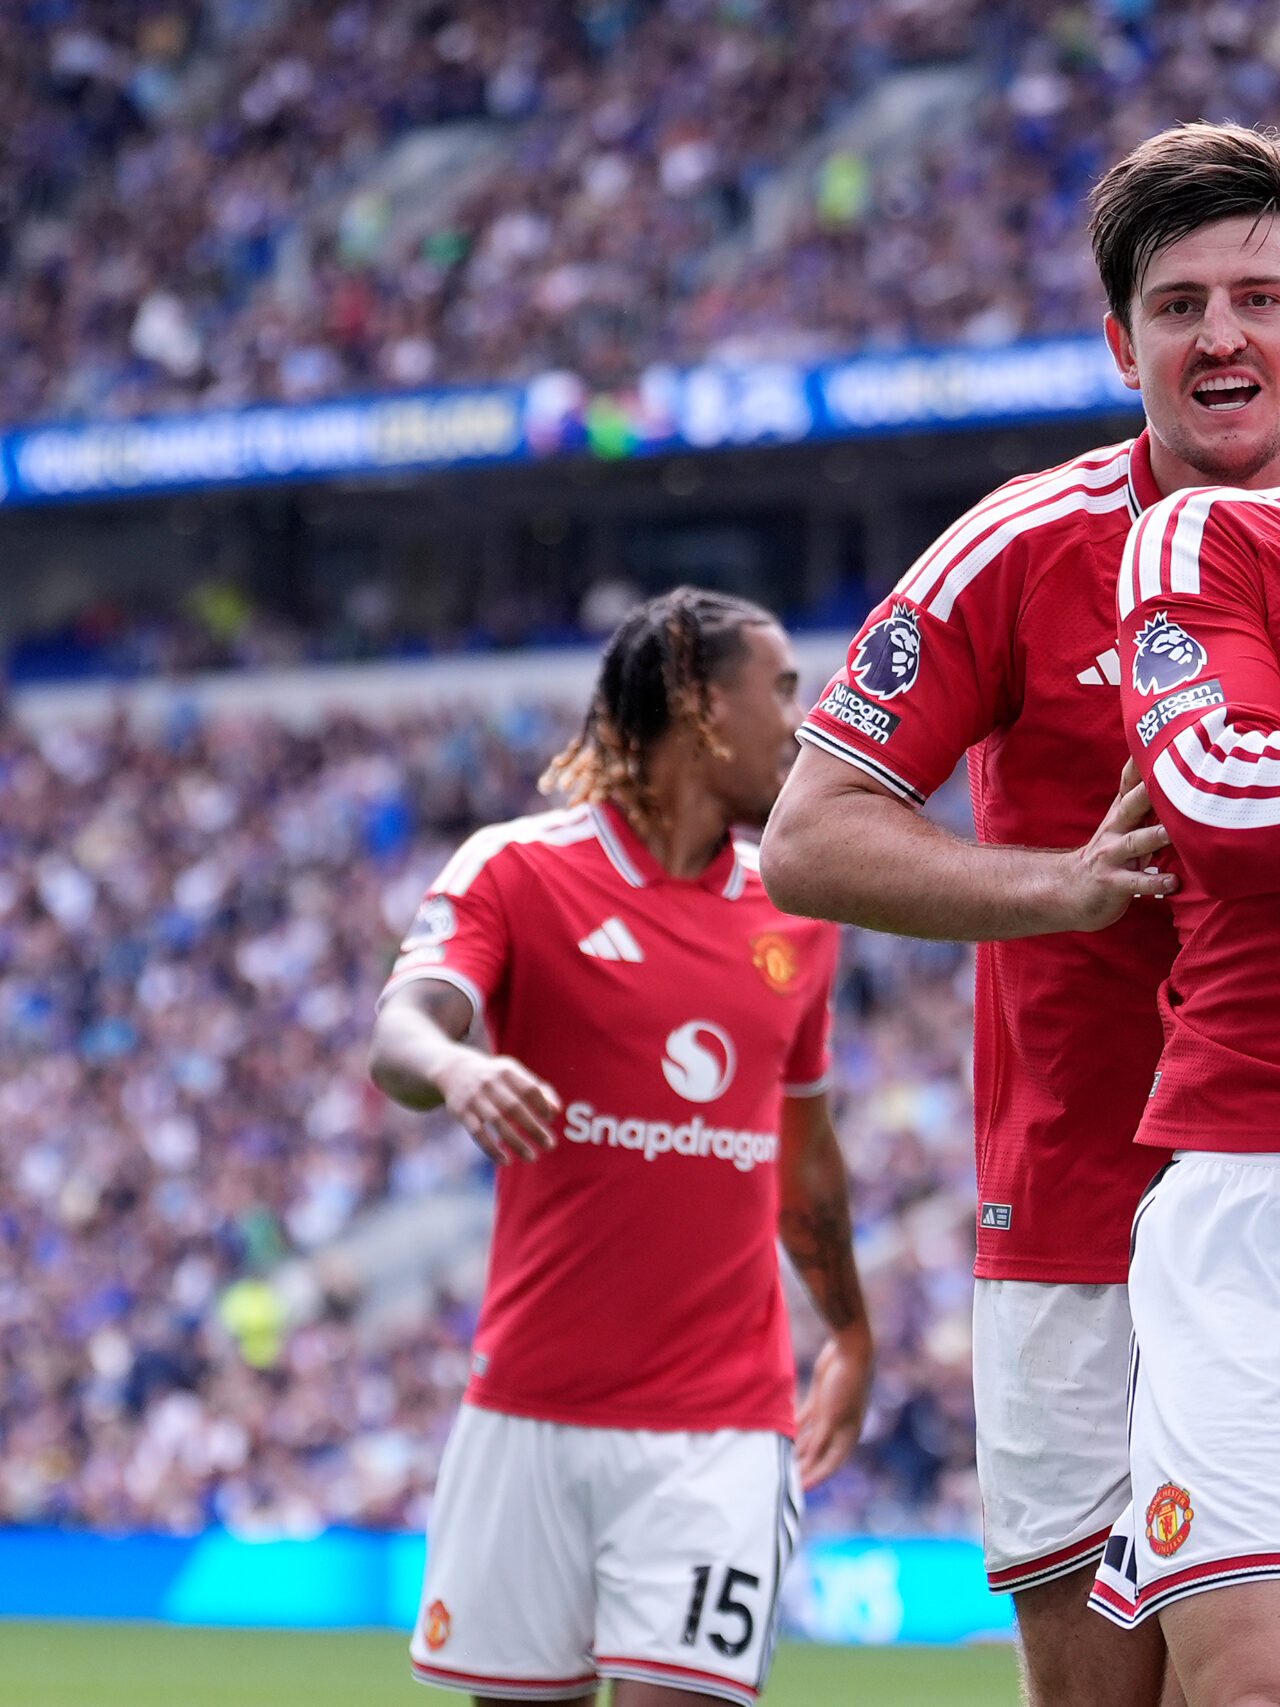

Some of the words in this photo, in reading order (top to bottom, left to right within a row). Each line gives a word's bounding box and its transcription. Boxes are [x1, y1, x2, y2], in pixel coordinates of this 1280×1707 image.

[819, 697, 842, 717] for
[839, 708, 889, 745] racism
[831, 683, 846, 702] No
[845, 693, 890, 728] room
[1136, 709, 1157, 732] No
[1158, 685, 1211, 713] room
[1141, 718, 1160, 748] for
[1160, 692, 1224, 725] racism
[563, 1101, 779, 1172] Snapdragon
[681, 1565, 760, 1659] 15
